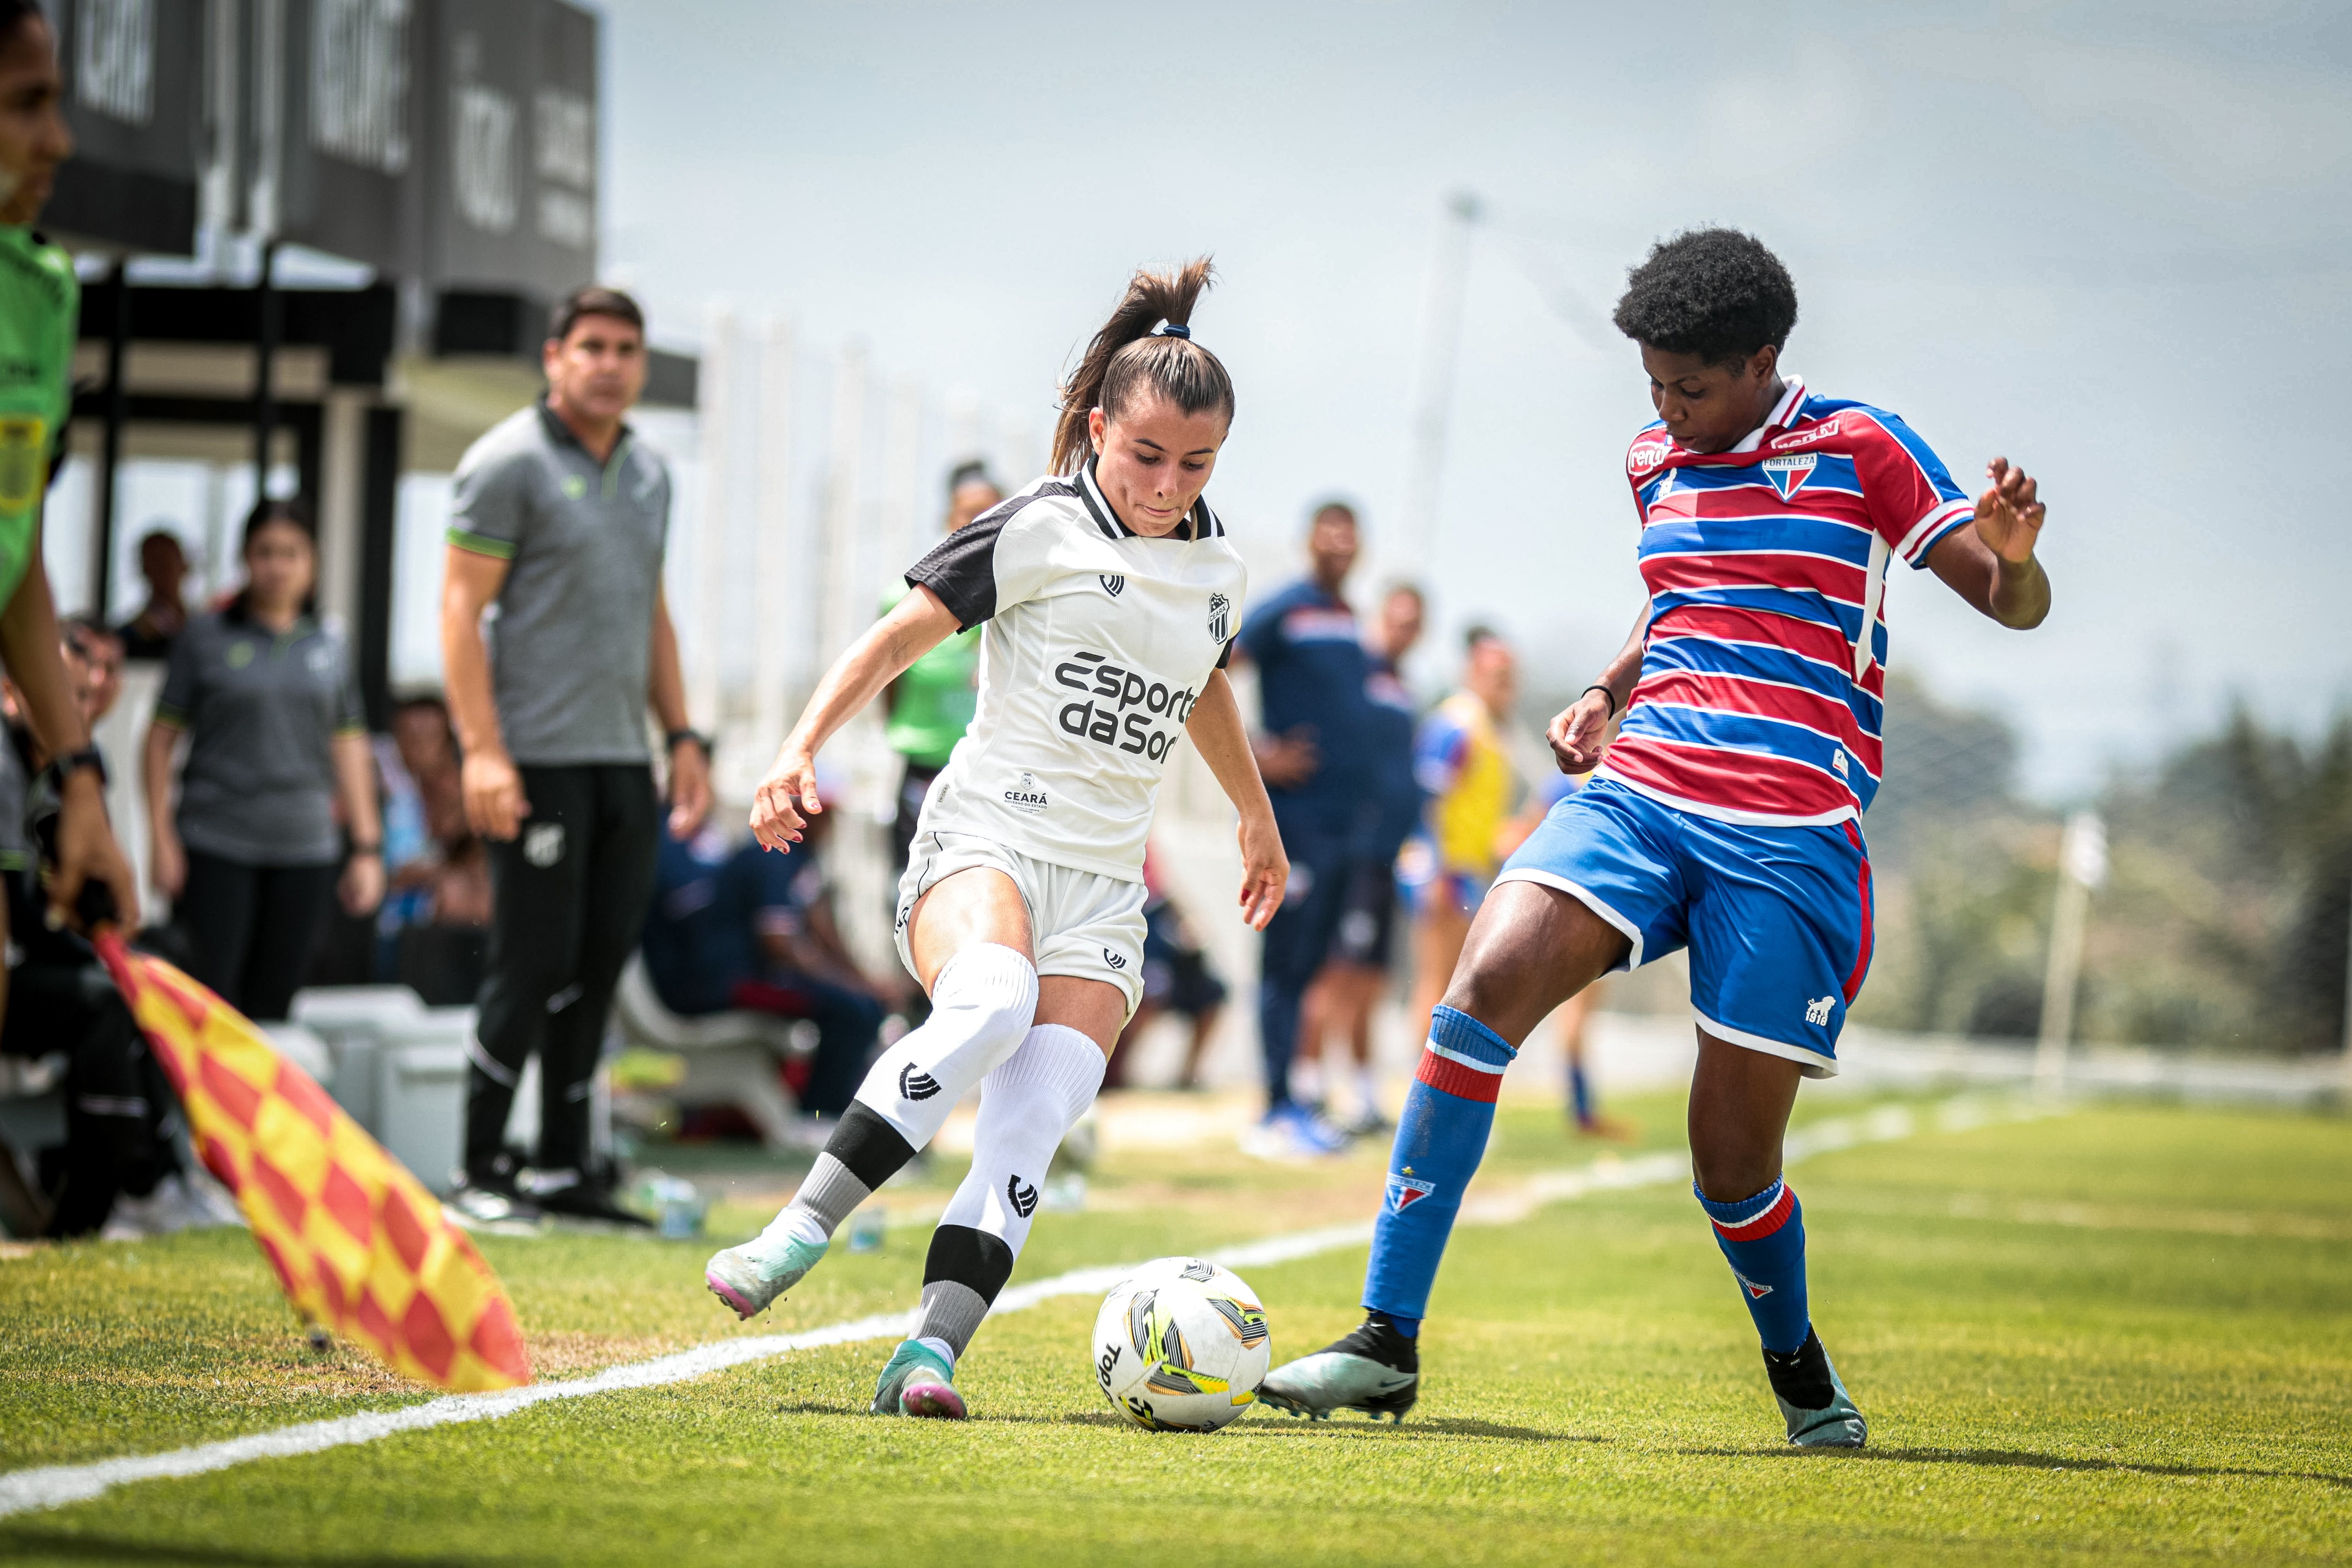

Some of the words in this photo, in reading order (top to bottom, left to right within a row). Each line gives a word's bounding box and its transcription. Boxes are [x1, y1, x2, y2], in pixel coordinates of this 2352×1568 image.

[1764, 456, 1815, 466] FORTALEZA
[1005, 791, 1047, 805] CEARÁ
[1805, 1011, 1827, 1026] 1918
